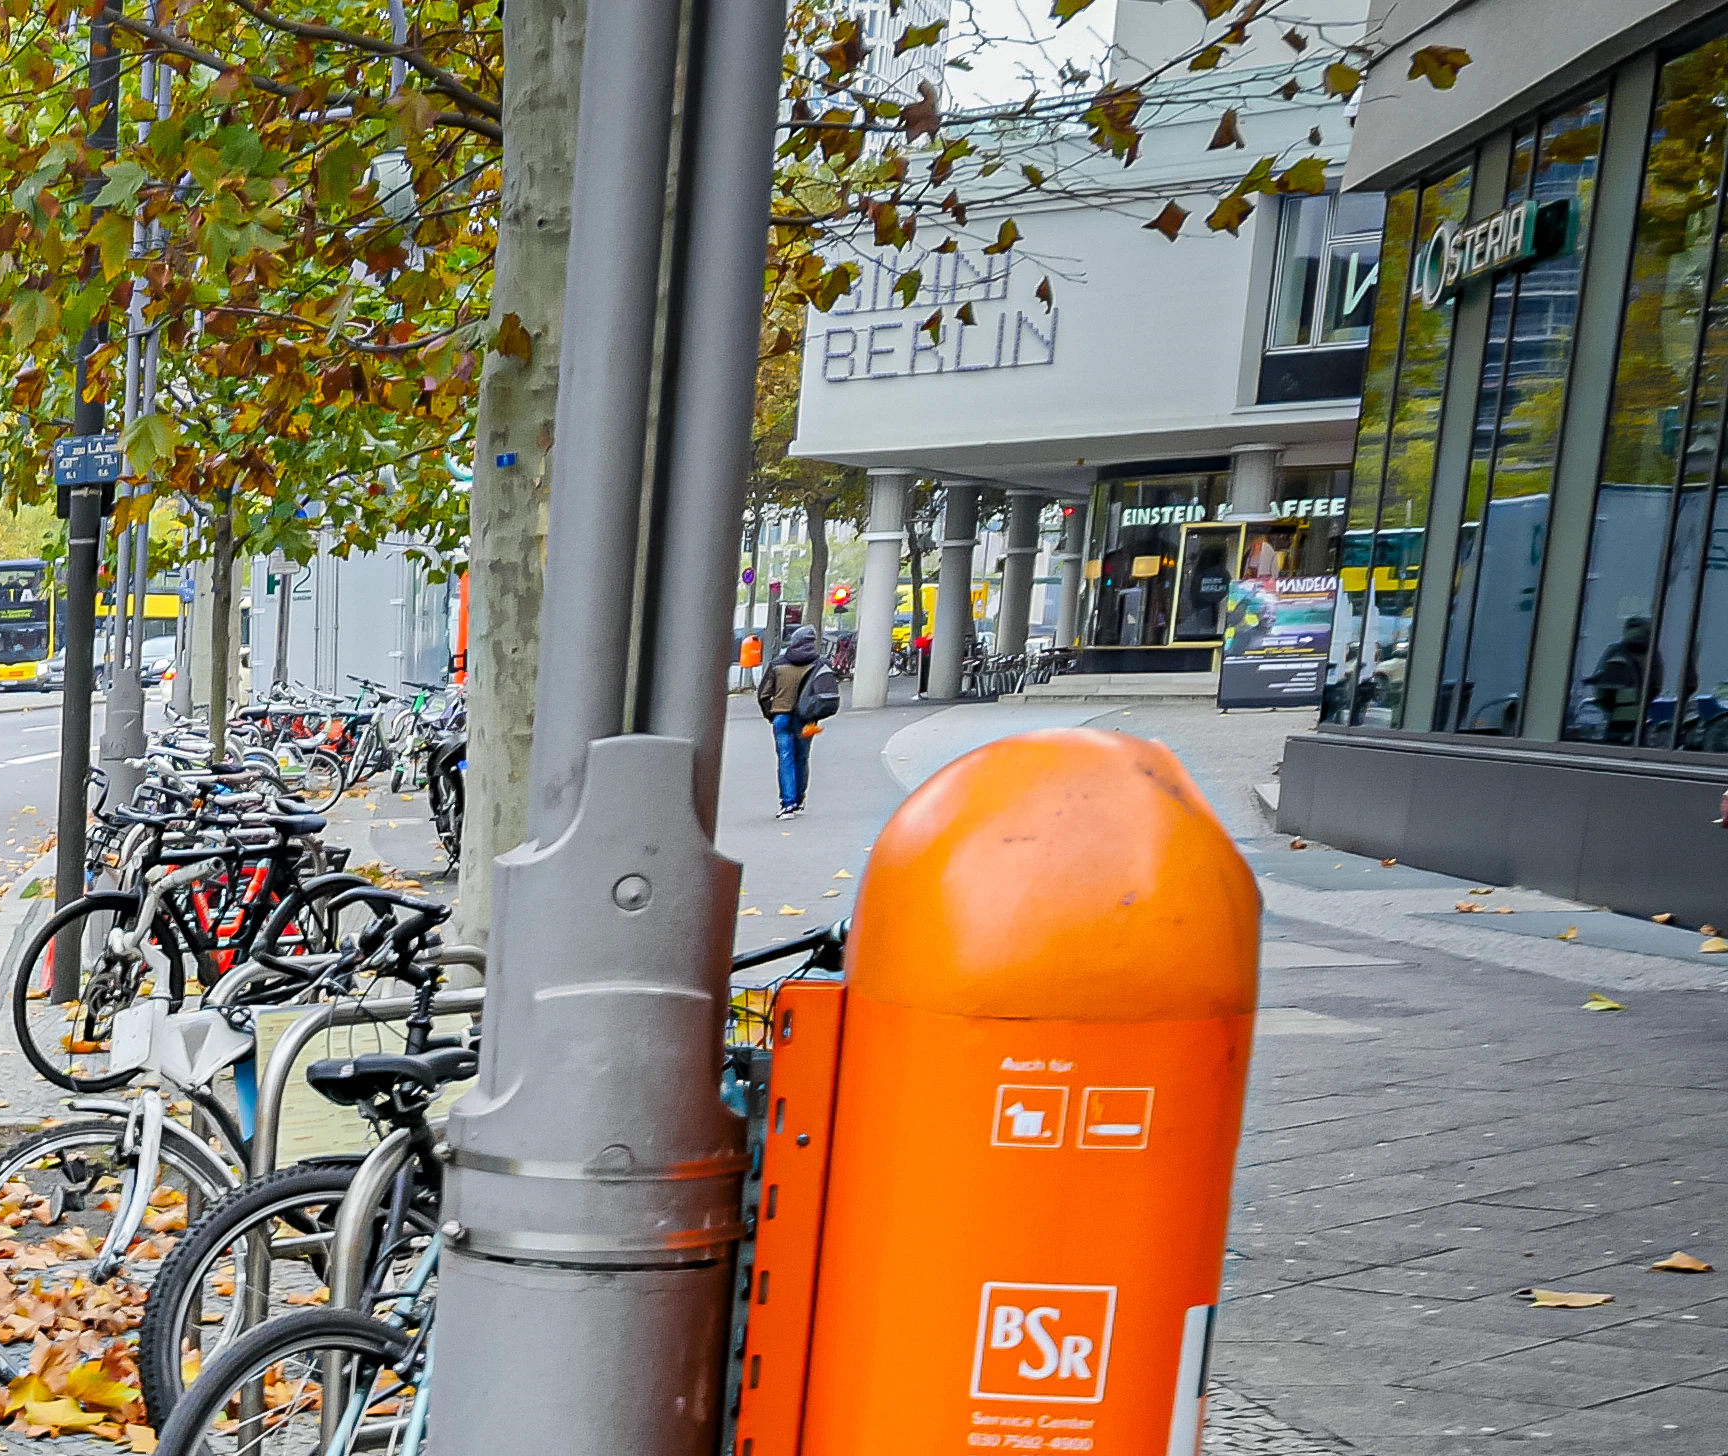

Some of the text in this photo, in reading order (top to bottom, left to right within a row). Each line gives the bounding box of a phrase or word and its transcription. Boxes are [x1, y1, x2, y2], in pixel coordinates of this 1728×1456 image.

[822, 307, 1059, 382] BERLIN
[1275, 577, 1337, 593] MANDELA
[990, 1305, 1094, 1380] BSR
[970, 1411, 1095, 1430] Service Center
